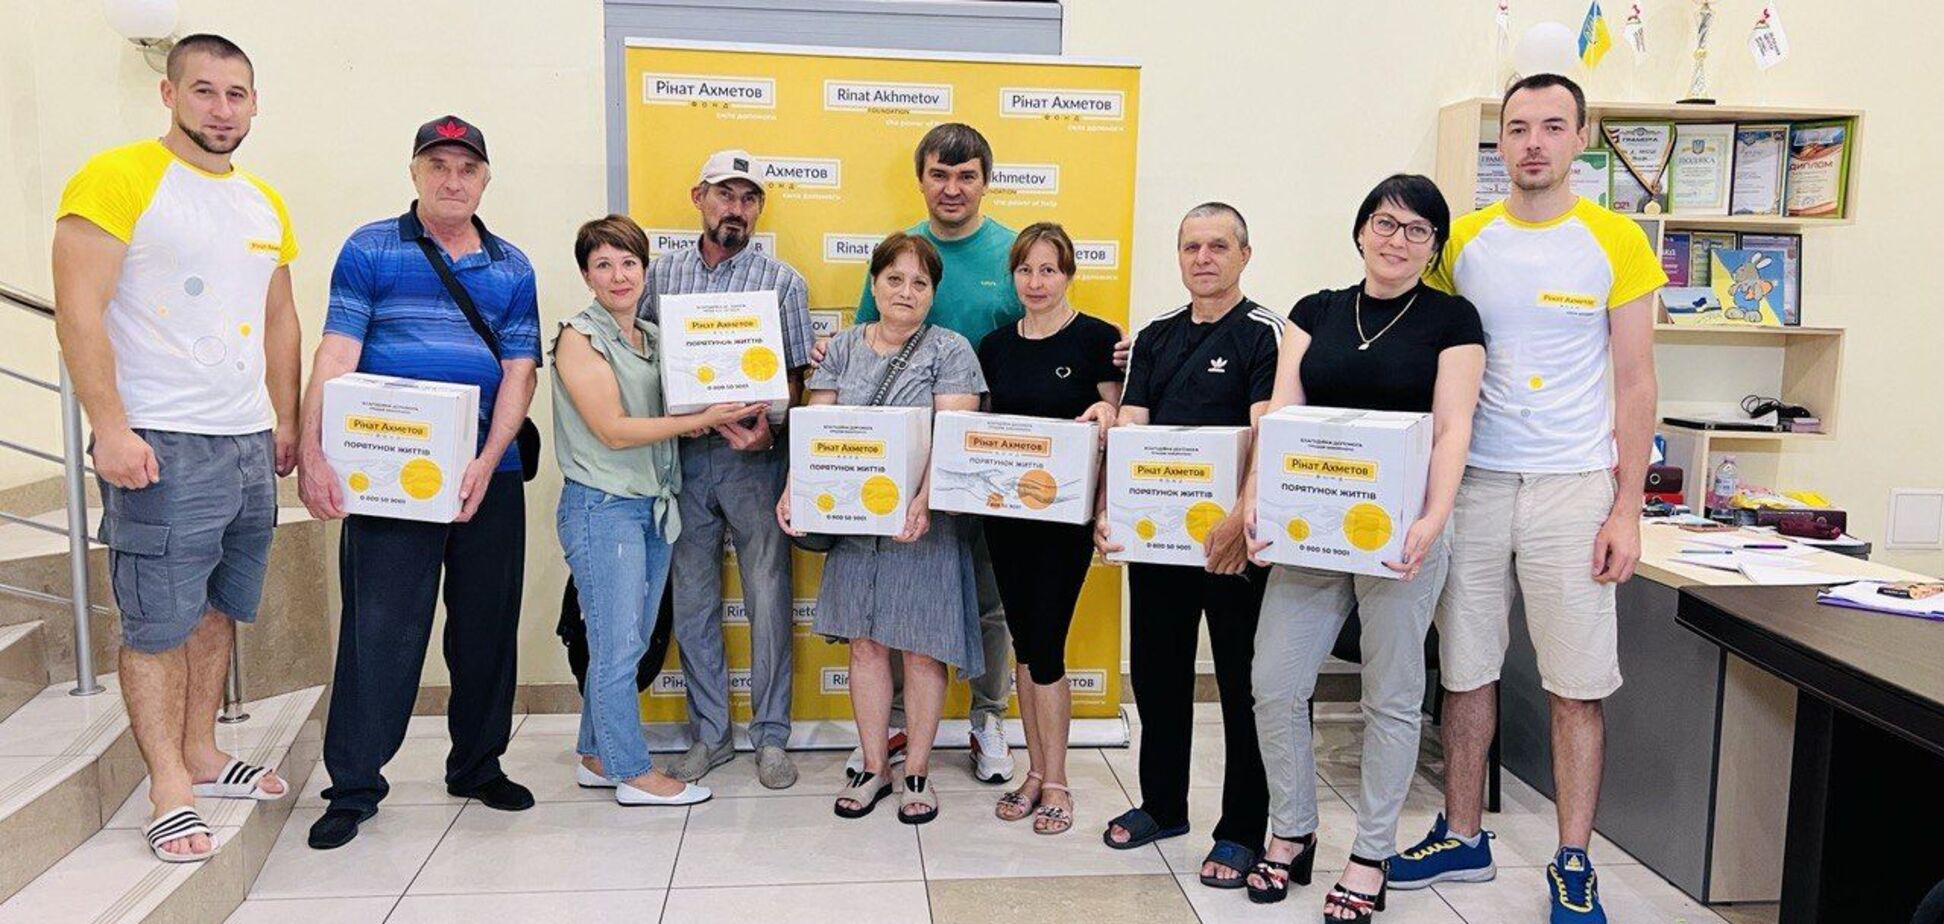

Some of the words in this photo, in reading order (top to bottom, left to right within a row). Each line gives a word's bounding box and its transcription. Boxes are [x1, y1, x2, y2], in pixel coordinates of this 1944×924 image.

[655, 79, 695, 96] Рінат
[698, 82, 763, 99] Ахметов
[836, 87, 870, 102] Rinat
[873, 89, 940, 105] Akhmetov
[1011, 94, 1048, 109] Рінат
[1051, 96, 1112, 111] Ахметов
[765, 164, 828, 179] Ахметов
[1789, 160, 1834, 172] ДИПЛОМ
[991, 170, 1047, 185] khmetov
[768, 181, 795, 189] ОНД
[836, 241, 869, 254] Rinat
[1075, 249, 1106, 261] етов
[354, 419, 380, 431] Рінат
[381, 422, 424, 436] Ахметов
[816, 442, 839, 452] Рінат
[841, 443, 879, 453] Ахметов
[972, 436, 999, 447] Рінат
[1001, 439, 1044, 452] Ахметов
[1137, 464, 1161, 475] Рінат
[1163, 465, 1205, 477] Ахметов
[1291, 457, 1319, 470] Рінат
[1322, 461, 1369, 477] Ахметов
[1281, 482, 1338, 496] ПОРЯТУНОК
[1339, 489, 1377, 500] ЖИТТІВ
[1306, 545, 1321, 553] 800
[1322, 546, 1331, 554] 50
[727, 605, 747, 617] Rin
[662, 676, 688, 689] Рін
